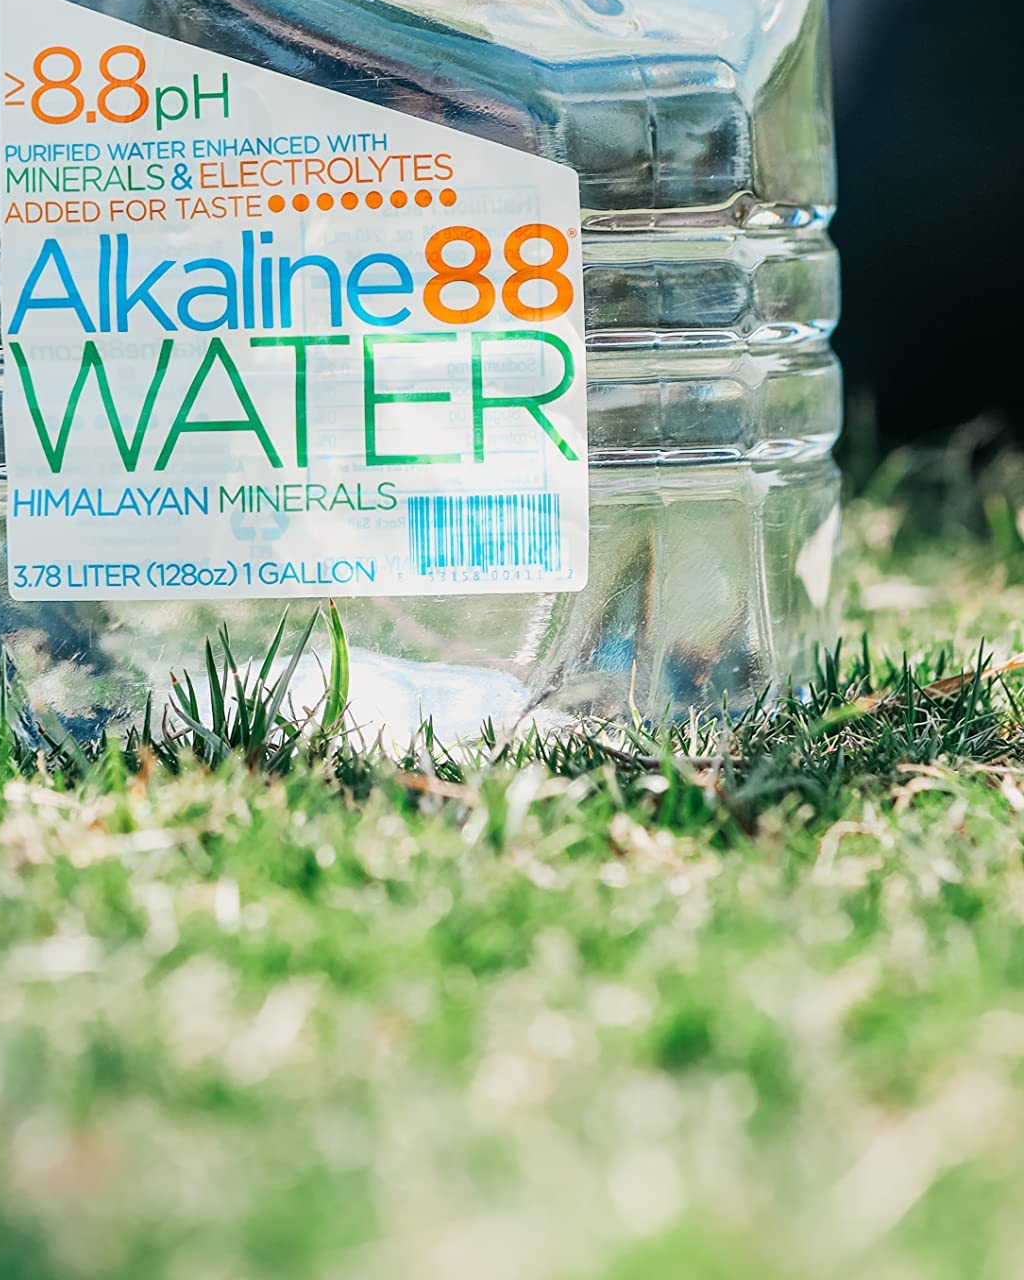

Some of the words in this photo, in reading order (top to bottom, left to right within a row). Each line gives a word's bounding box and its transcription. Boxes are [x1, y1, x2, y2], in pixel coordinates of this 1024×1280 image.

[5, 143, 100, 162] PURIFIED
[107, 140, 185, 160] WATER
[192, 136, 321, 157] ENHANCED
[326, 133, 387, 152] WITH
[6, 163, 164, 193] MINERALS
[170, 163, 193, 190] &
[199, 154, 454, 188] ELECTROLYTES
[5, 200, 101, 224] ADDED
[111, 200, 167, 221] FOR
[175, 197, 262, 220] TASTE
[9, 330, 580, 474] WATER
[14, 486, 209, 517] HIMALAYAN
[219, 482, 398, 513] MINERALS
[14, 565, 62, 588] 3.78
[67, 564, 141, 588] LITER
[146, 562, 238, 587] (128oz)
[243, 563, 251, 585] 1
[258, 560, 376, 586] GALLON
